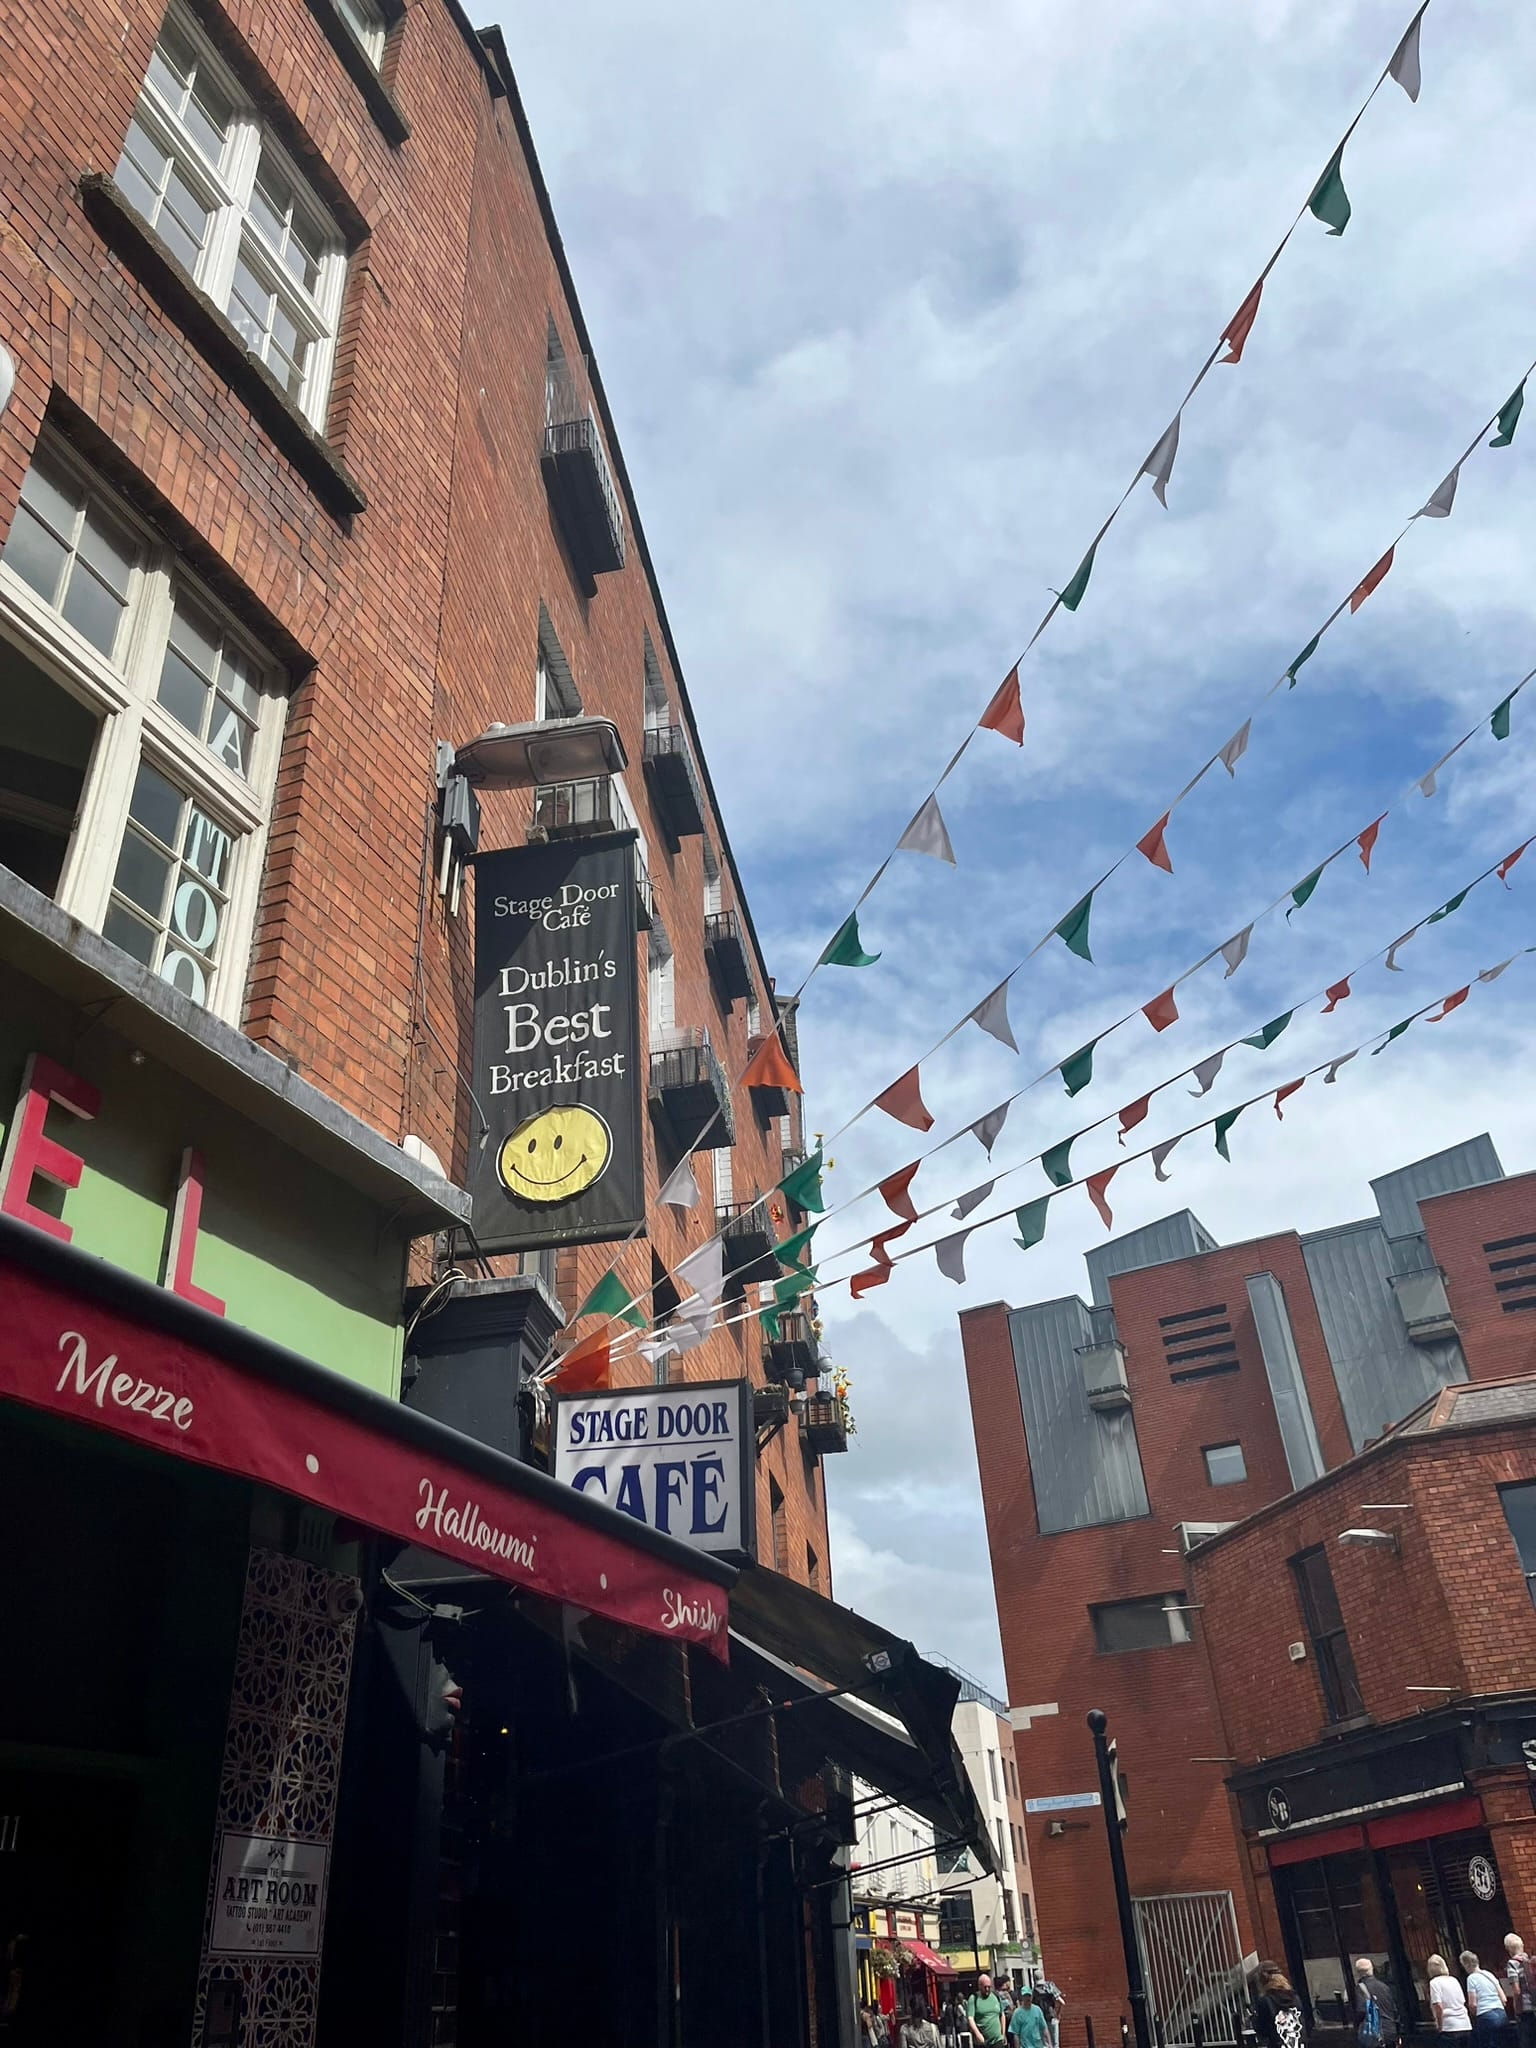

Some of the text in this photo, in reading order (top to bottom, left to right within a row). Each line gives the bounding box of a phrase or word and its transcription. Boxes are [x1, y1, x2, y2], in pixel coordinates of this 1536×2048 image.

[494, 883, 620, 920] Stage Door
[542, 905, 592, 932] Café
[498, 949, 617, 997] Dublin's
[504, 1002, 612, 1054] Best
[489, 1051, 626, 1095] Breakfast
[56, 1331, 195, 1430] Mezze
[570, 1402, 730, 1444] STAGE DOOR
[415, 1478, 538, 1571] Halloumi
[660, 1588, 725, 1636] Shish
[223, 1876, 319, 1907] ART ROOM
[269, 1867, 280, 1878] THE
[226, 1905, 313, 1922] TATTOO STUDIO ART ACADEMY
[252, 1923, 264, 1935] (01)
